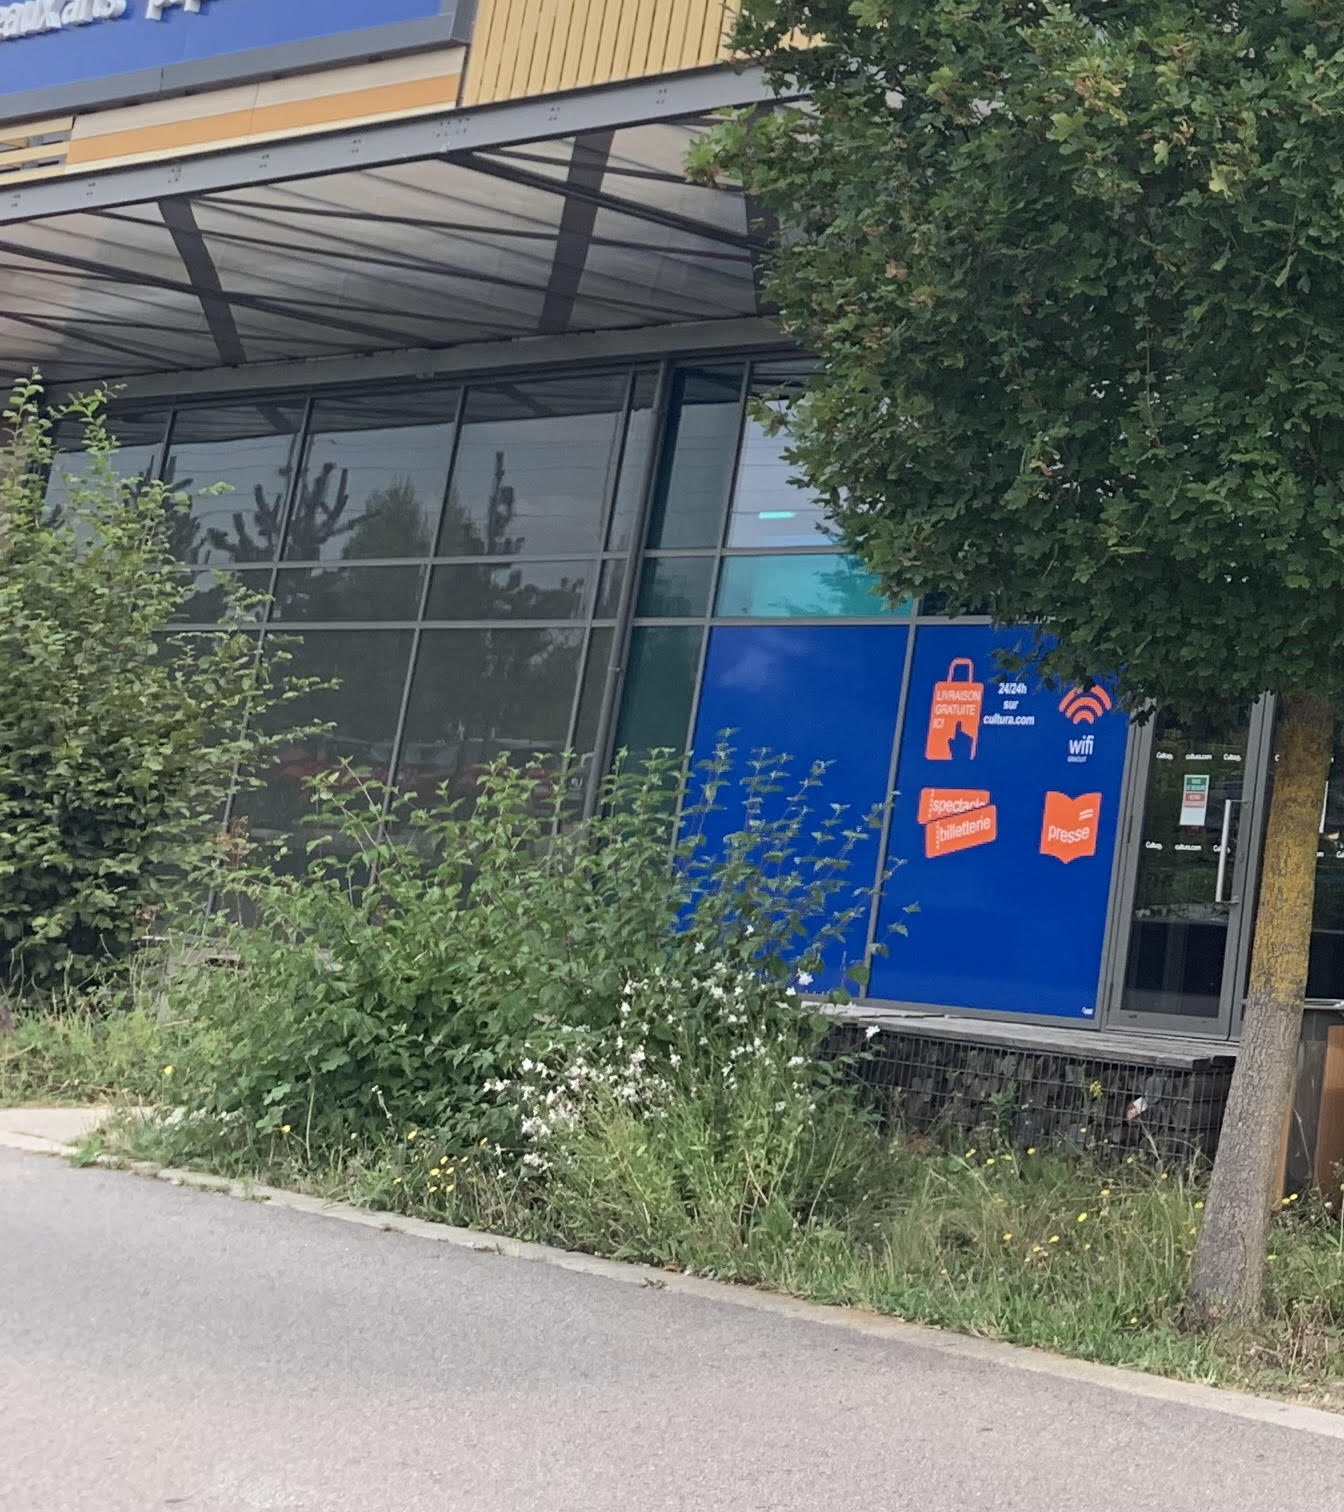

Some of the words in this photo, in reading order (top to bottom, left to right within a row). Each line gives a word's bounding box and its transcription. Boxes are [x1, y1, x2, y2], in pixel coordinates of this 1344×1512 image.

[936, 690, 981, 701] LIVRAISON
[935, 704, 976, 716] GRATUITE
[1003, 700, 1019, 710] sur
[983, 713, 1035, 725] cultura.com
[1068, 735, 1094, 755] wifi
[931, 797, 989, 815] spectacl
[939, 815, 992, 842] billetterie
[1047, 825, 1091, 844] presse
